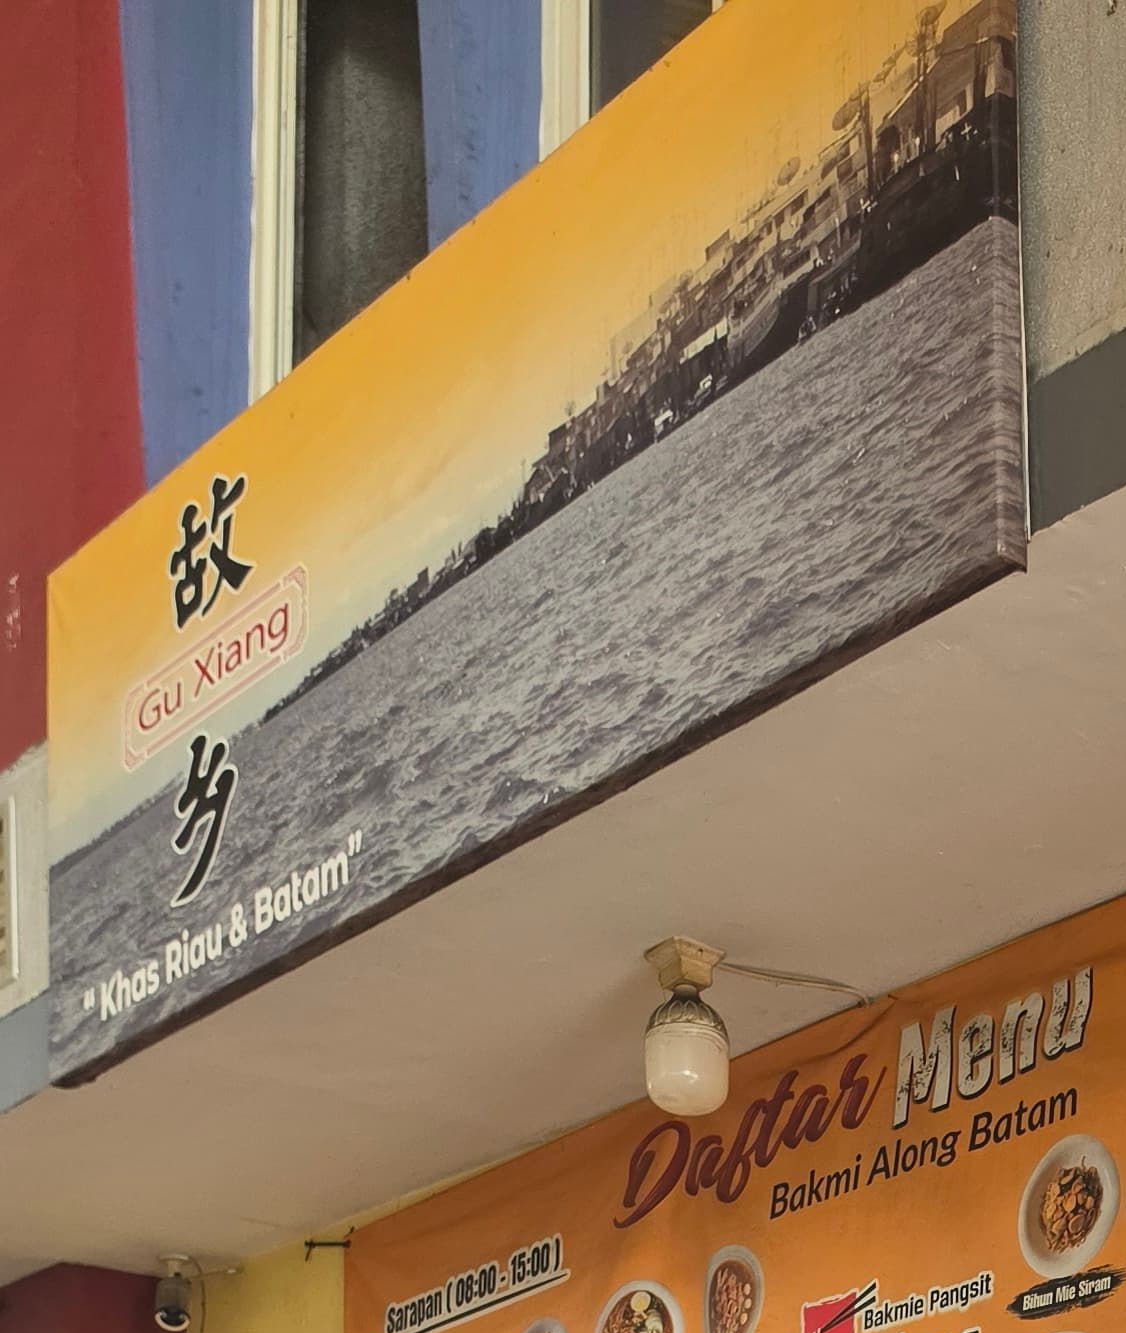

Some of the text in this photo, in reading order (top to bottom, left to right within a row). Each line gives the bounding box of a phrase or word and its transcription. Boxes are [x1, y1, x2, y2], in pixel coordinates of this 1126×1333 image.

[171, 475, 255, 629] 故
[137, 600, 290, 734] Gu Xiang
[172, 735, 237, 906] 乡
[165, 923, 223, 984] Riau
[228, 905, 249, 949] &
[614, 966, 1094, 1229] Daftar Menu
[769, 1087, 1078, 1220] Bakmi Along Batam
[456, 1265, 497, 1307] 08:00
[511, 1242, 550, 1285] 15:00
[863, 1273, 992, 1331] Bakmie Pangsit
[1022, 1275, 1112, 1312] Bihun Mie Siram
